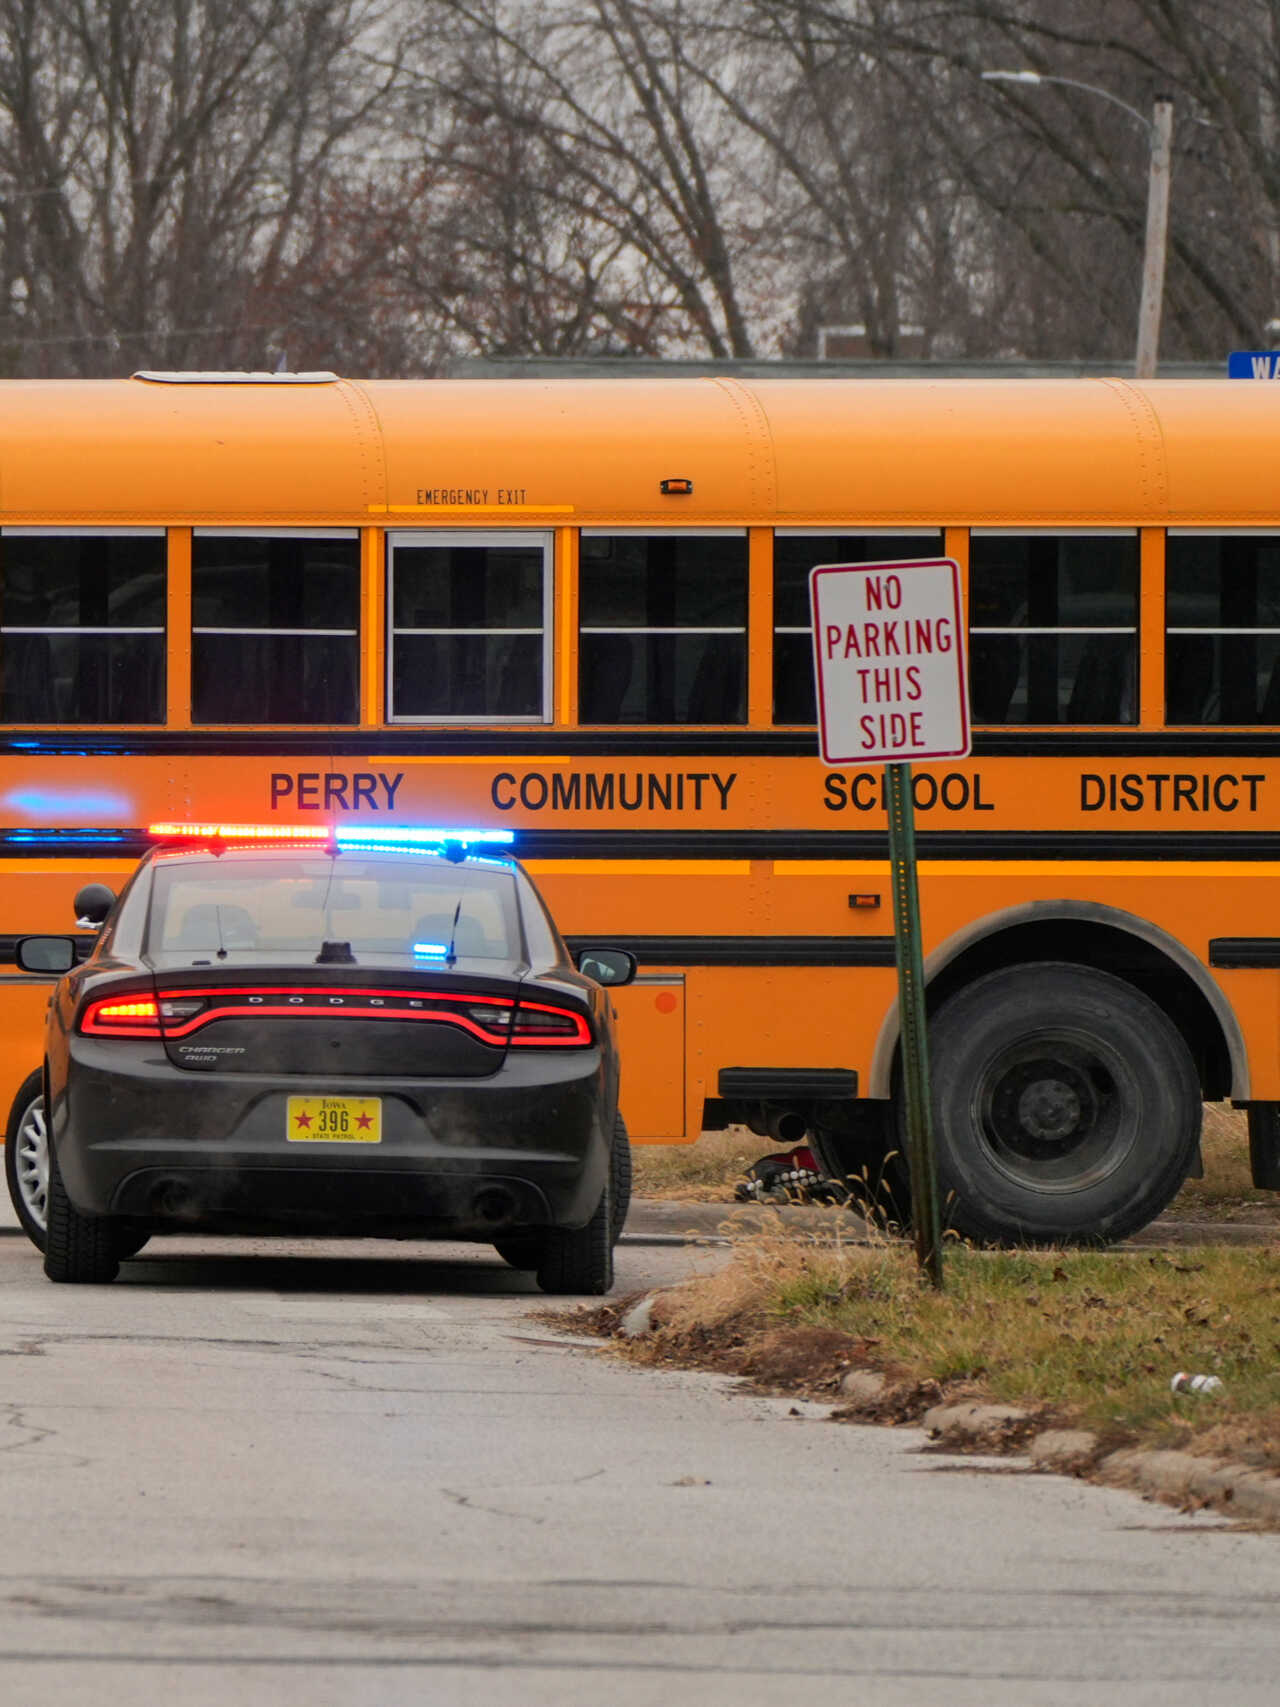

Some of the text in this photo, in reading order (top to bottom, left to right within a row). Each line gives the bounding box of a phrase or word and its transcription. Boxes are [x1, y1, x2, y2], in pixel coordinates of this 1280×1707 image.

[416, 489, 527, 505] EMERGENCY EXIT
[865, 575, 902, 611] NO
[826, 618, 952, 660] PARKING
[857, 666, 922, 703] THIS
[860, 712, 925, 750] SIDE
[270, 773, 1266, 811] PERRY COMMUNITY SCOOL DISTRICT
[248, 996, 424, 1007] DODGE
[178, 1046, 245, 1055] CHARGER
[318, 1110, 350, 1132] 396
